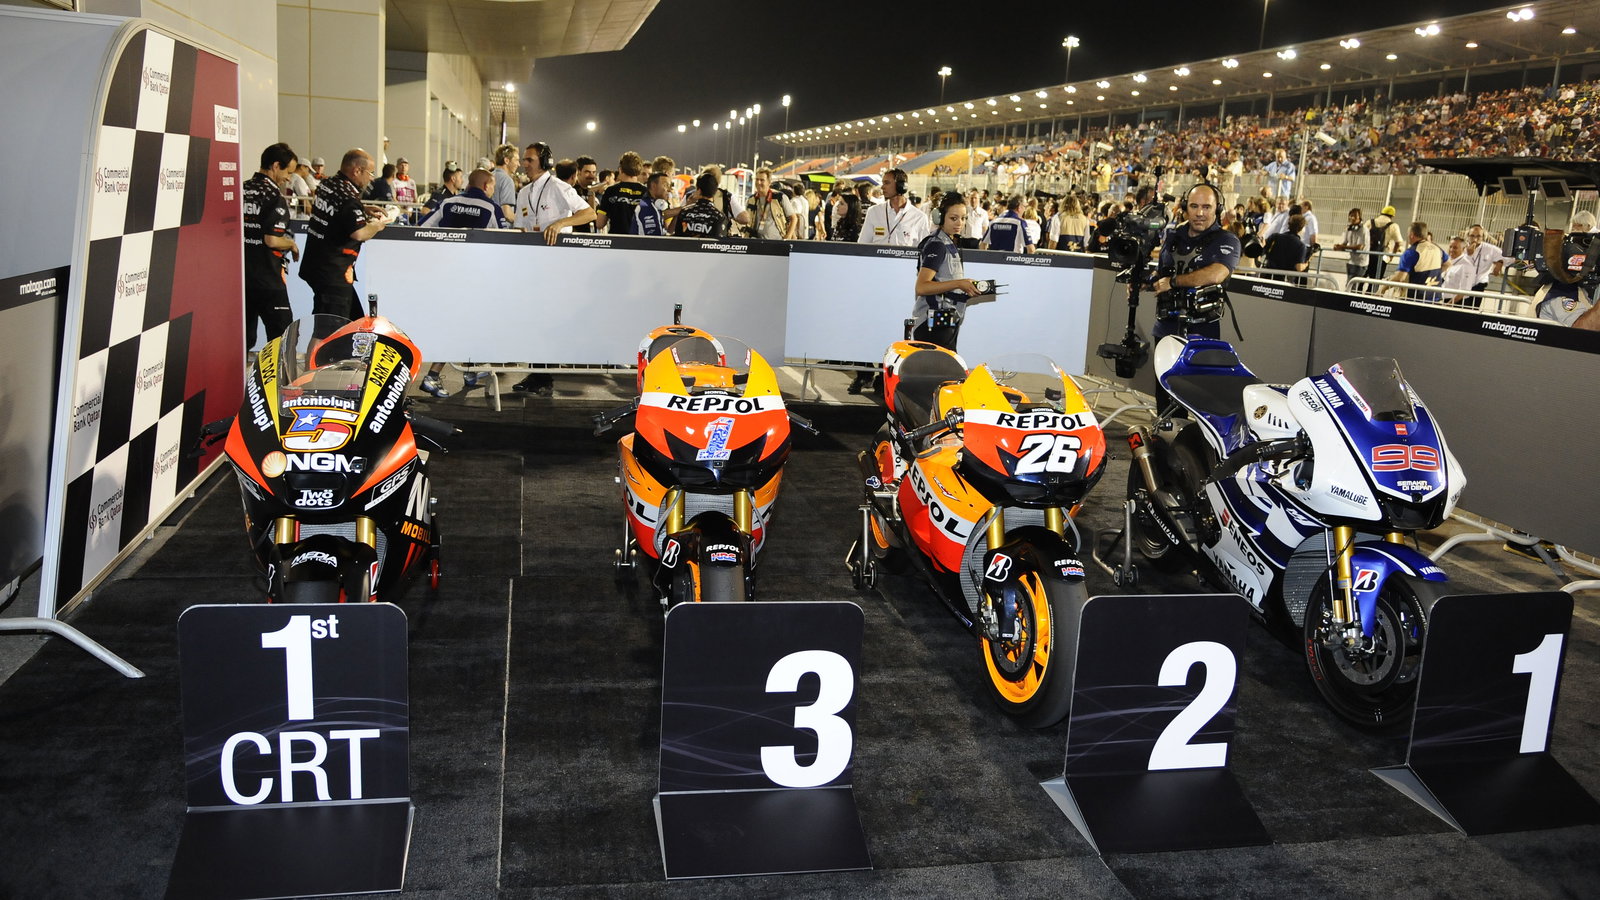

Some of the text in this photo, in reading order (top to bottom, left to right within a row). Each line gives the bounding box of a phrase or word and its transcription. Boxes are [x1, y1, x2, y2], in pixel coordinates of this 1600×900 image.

[150, 67, 169, 82] Commercial
[150, 80, 169, 95] Bank Qatar
[104, 167, 129, 179] Commercial
[166, 168, 185, 178] Commercial
[104, 181, 128, 195] Bank Qatar
[166, 180, 184, 192] Bank Qatar
[414, 230, 467, 240] motogp.com
[562, 236, 612, 246] motogp.com
[701, 242, 748, 252] motogp.com
[1006, 256, 1052, 264] motogp.com
[125, 267, 147, 284] Commercial
[19, 277, 57, 296] motogp.com
[125, 282, 146, 296] Bank Qatar
[1251, 285, 1284, 296] motogp.com
[1350, 300, 1392, 313] motogp.com
[1481, 321, 1539, 337] motogp.com
[143, 358, 164, 378] Commercial
[369, 362, 390, 388] DARK
[143, 373, 163, 391] Bank Qatar
[282, 396, 355, 410] antoniolupi
[369, 361, 411, 434] antoniolupi
[1314, 378, 1345, 409] YAMAHA
[74, 391, 101, 417] Commercial
[667, 395, 764, 414] REPSOL
[74, 409, 101, 432] Bank Qatar
[280, 406, 361, 453] 5
[996, 412, 1086, 430] REPSOL
[285, 452, 361, 474] NGM
[1014, 433, 1082, 476] 26
[1371, 444, 1441, 473] 99
[380, 466, 410, 493] GPS
[97, 485, 124, 515] Commercial
[910, 463, 968, 539] EPSOL
[1330, 485, 1369, 506] YAMALUBE
[98, 502, 123, 529] Bank Qatar
[705, 544, 740, 553] REPSOL
[1227, 520, 1266, 576] ENEOS
[261, 614, 340, 721] 1st
[1512, 633, 1564, 754] 1
[1147, 641, 1237, 771] 2
[760, 649, 855, 788] 3
[220, 728, 381, 806] CRT
